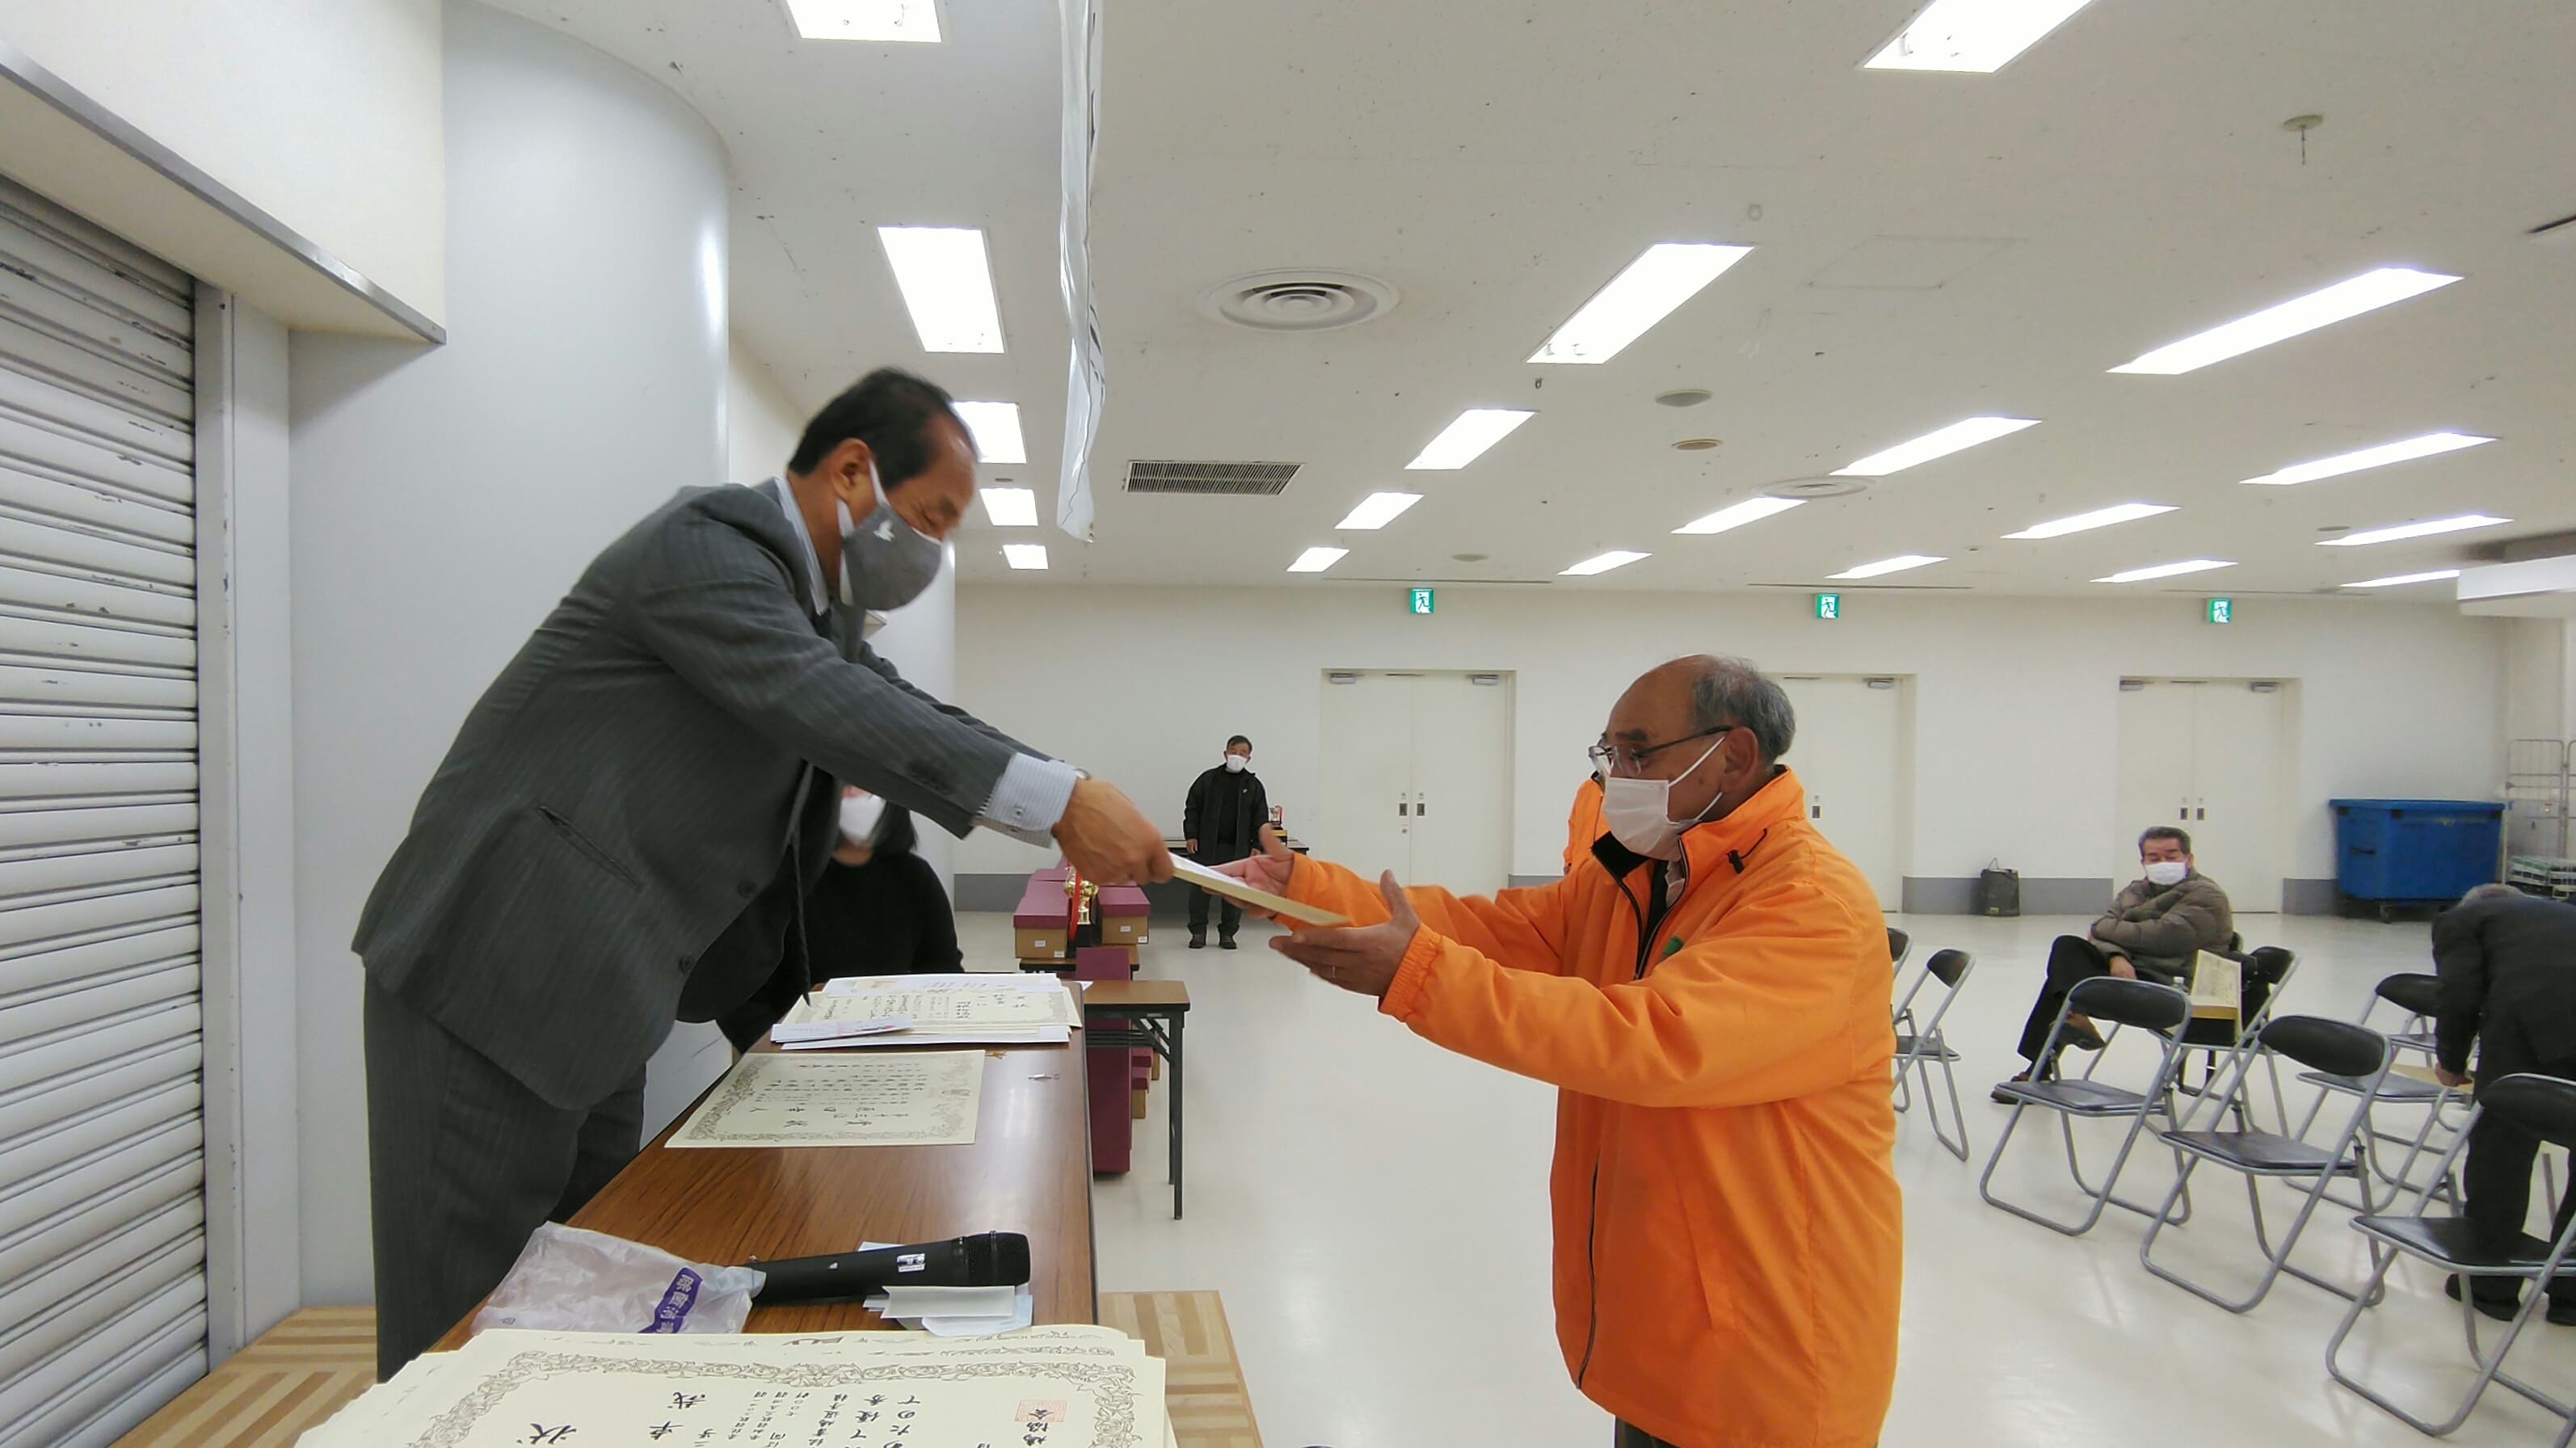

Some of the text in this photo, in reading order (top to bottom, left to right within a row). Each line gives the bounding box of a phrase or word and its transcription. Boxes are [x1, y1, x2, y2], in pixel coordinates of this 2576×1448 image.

[516, 1423, 578, 1445] 状
[844, 1394, 888, 1448] て優秀
